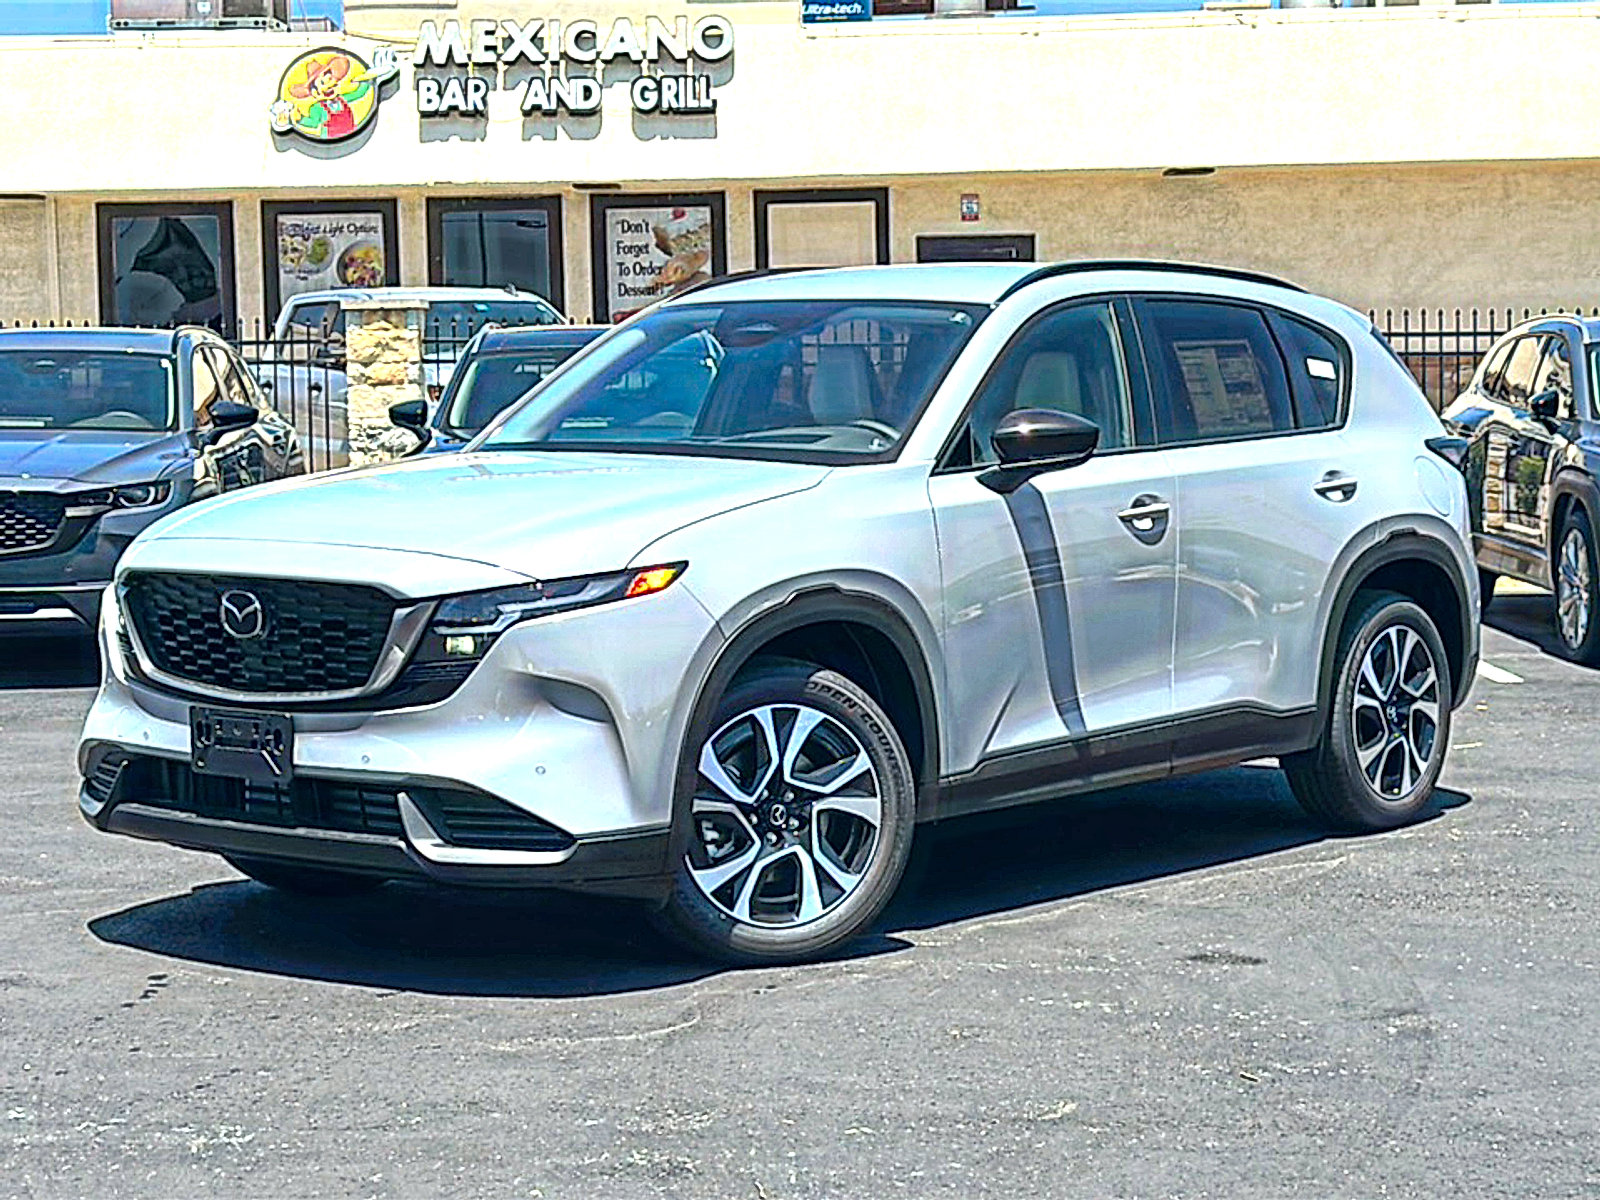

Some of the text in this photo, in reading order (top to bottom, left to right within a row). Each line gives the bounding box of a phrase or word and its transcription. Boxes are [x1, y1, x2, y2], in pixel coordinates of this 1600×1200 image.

[413, 15, 735, 66] MEXICANO
[417, 75, 717, 114] BAR AND GRILL
[616, 240, 650, 257] Forget
[616, 261, 662, 277] To Order
